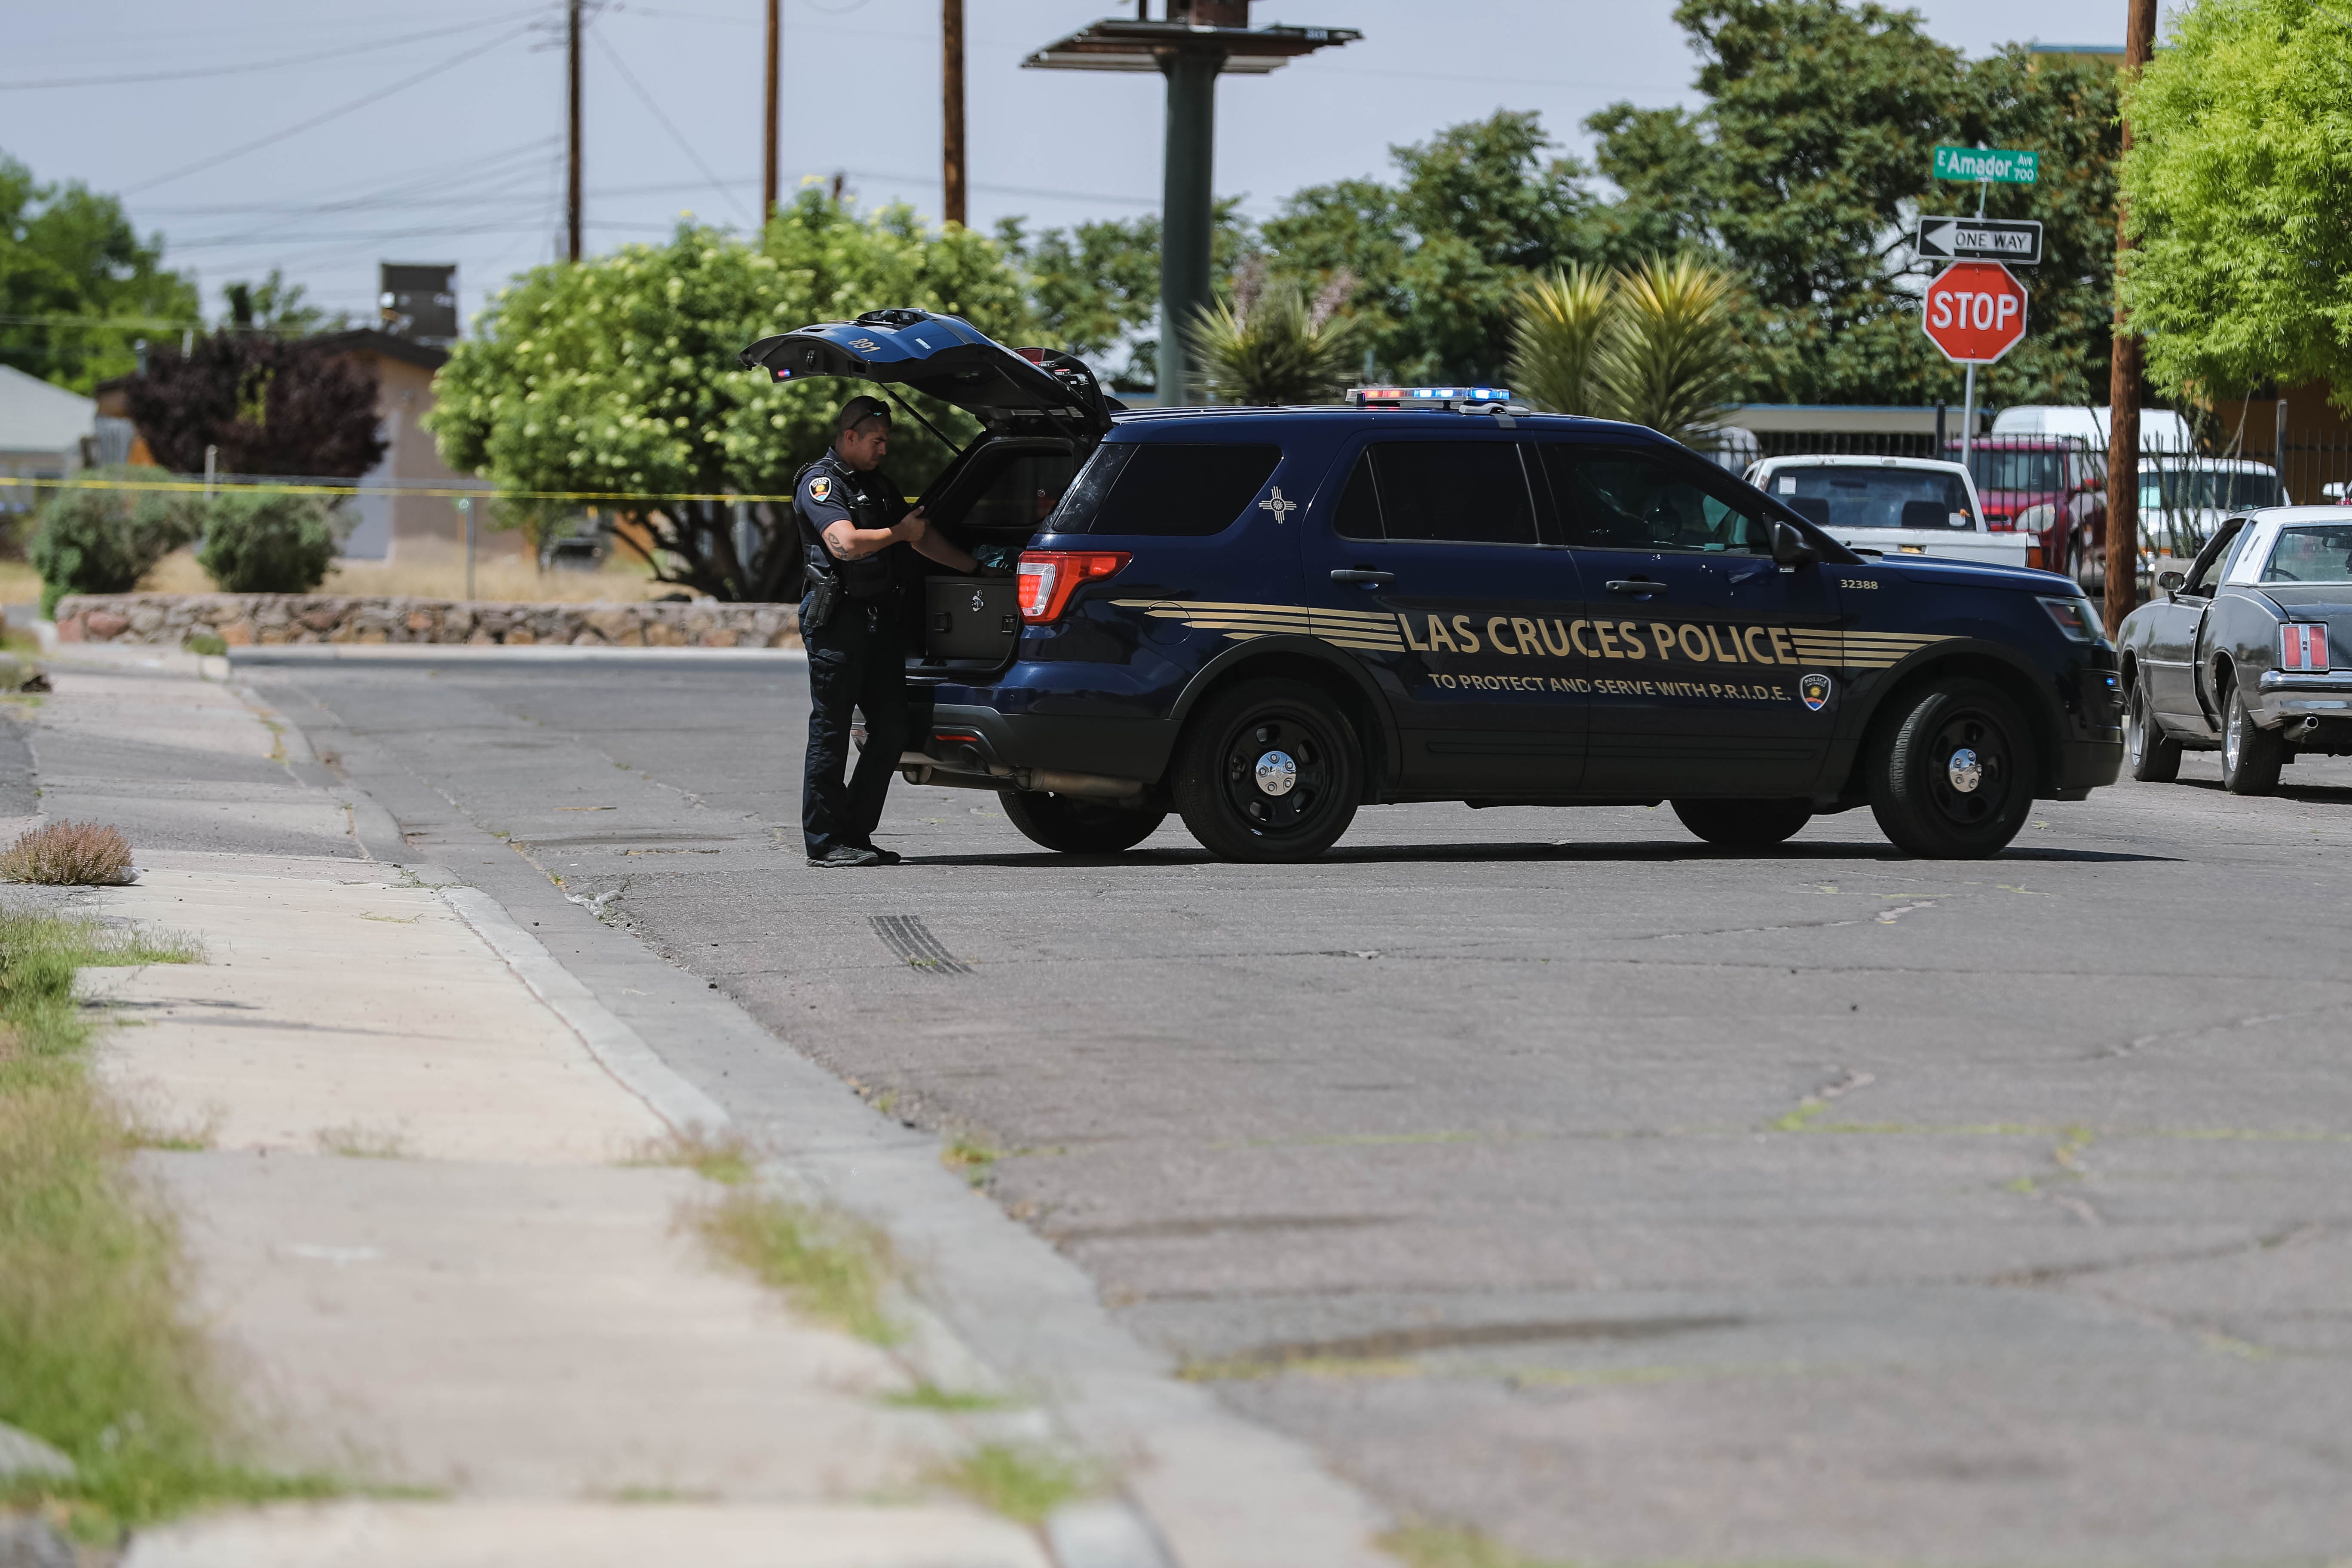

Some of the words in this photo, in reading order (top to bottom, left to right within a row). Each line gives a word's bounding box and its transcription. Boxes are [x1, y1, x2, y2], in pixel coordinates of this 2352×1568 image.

[1938, 150, 1946, 166] E
[1947, 151, 2012, 178] Amador
[2017, 153, 2034, 167] Ave
[2014, 167, 2034, 181] 700
[1956, 230, 1988, 247] ONE
[1994, 233, 2027, 250] WAY
[1931, 290, 2018, 331] STOP
[848, 338, 881, 353] 891
[1841, 579, 1878, 590] 32388
[1397, 613, 1480, 653] LAS
[1487, 616, 1647, 659] CRUCES
[1650, 623, 1798, 665] POLICE
[1428, 674, 1456, 688] TO
[1459, 674, 1546, 691] PROTECT
[1550, 677, 1591, 693] AND
[1594, 679, 1656, 695] SERVE
[1655, 682, 1709, 697] WITH
[1709, 684, 1792, 701] P.R.I.D.E.
